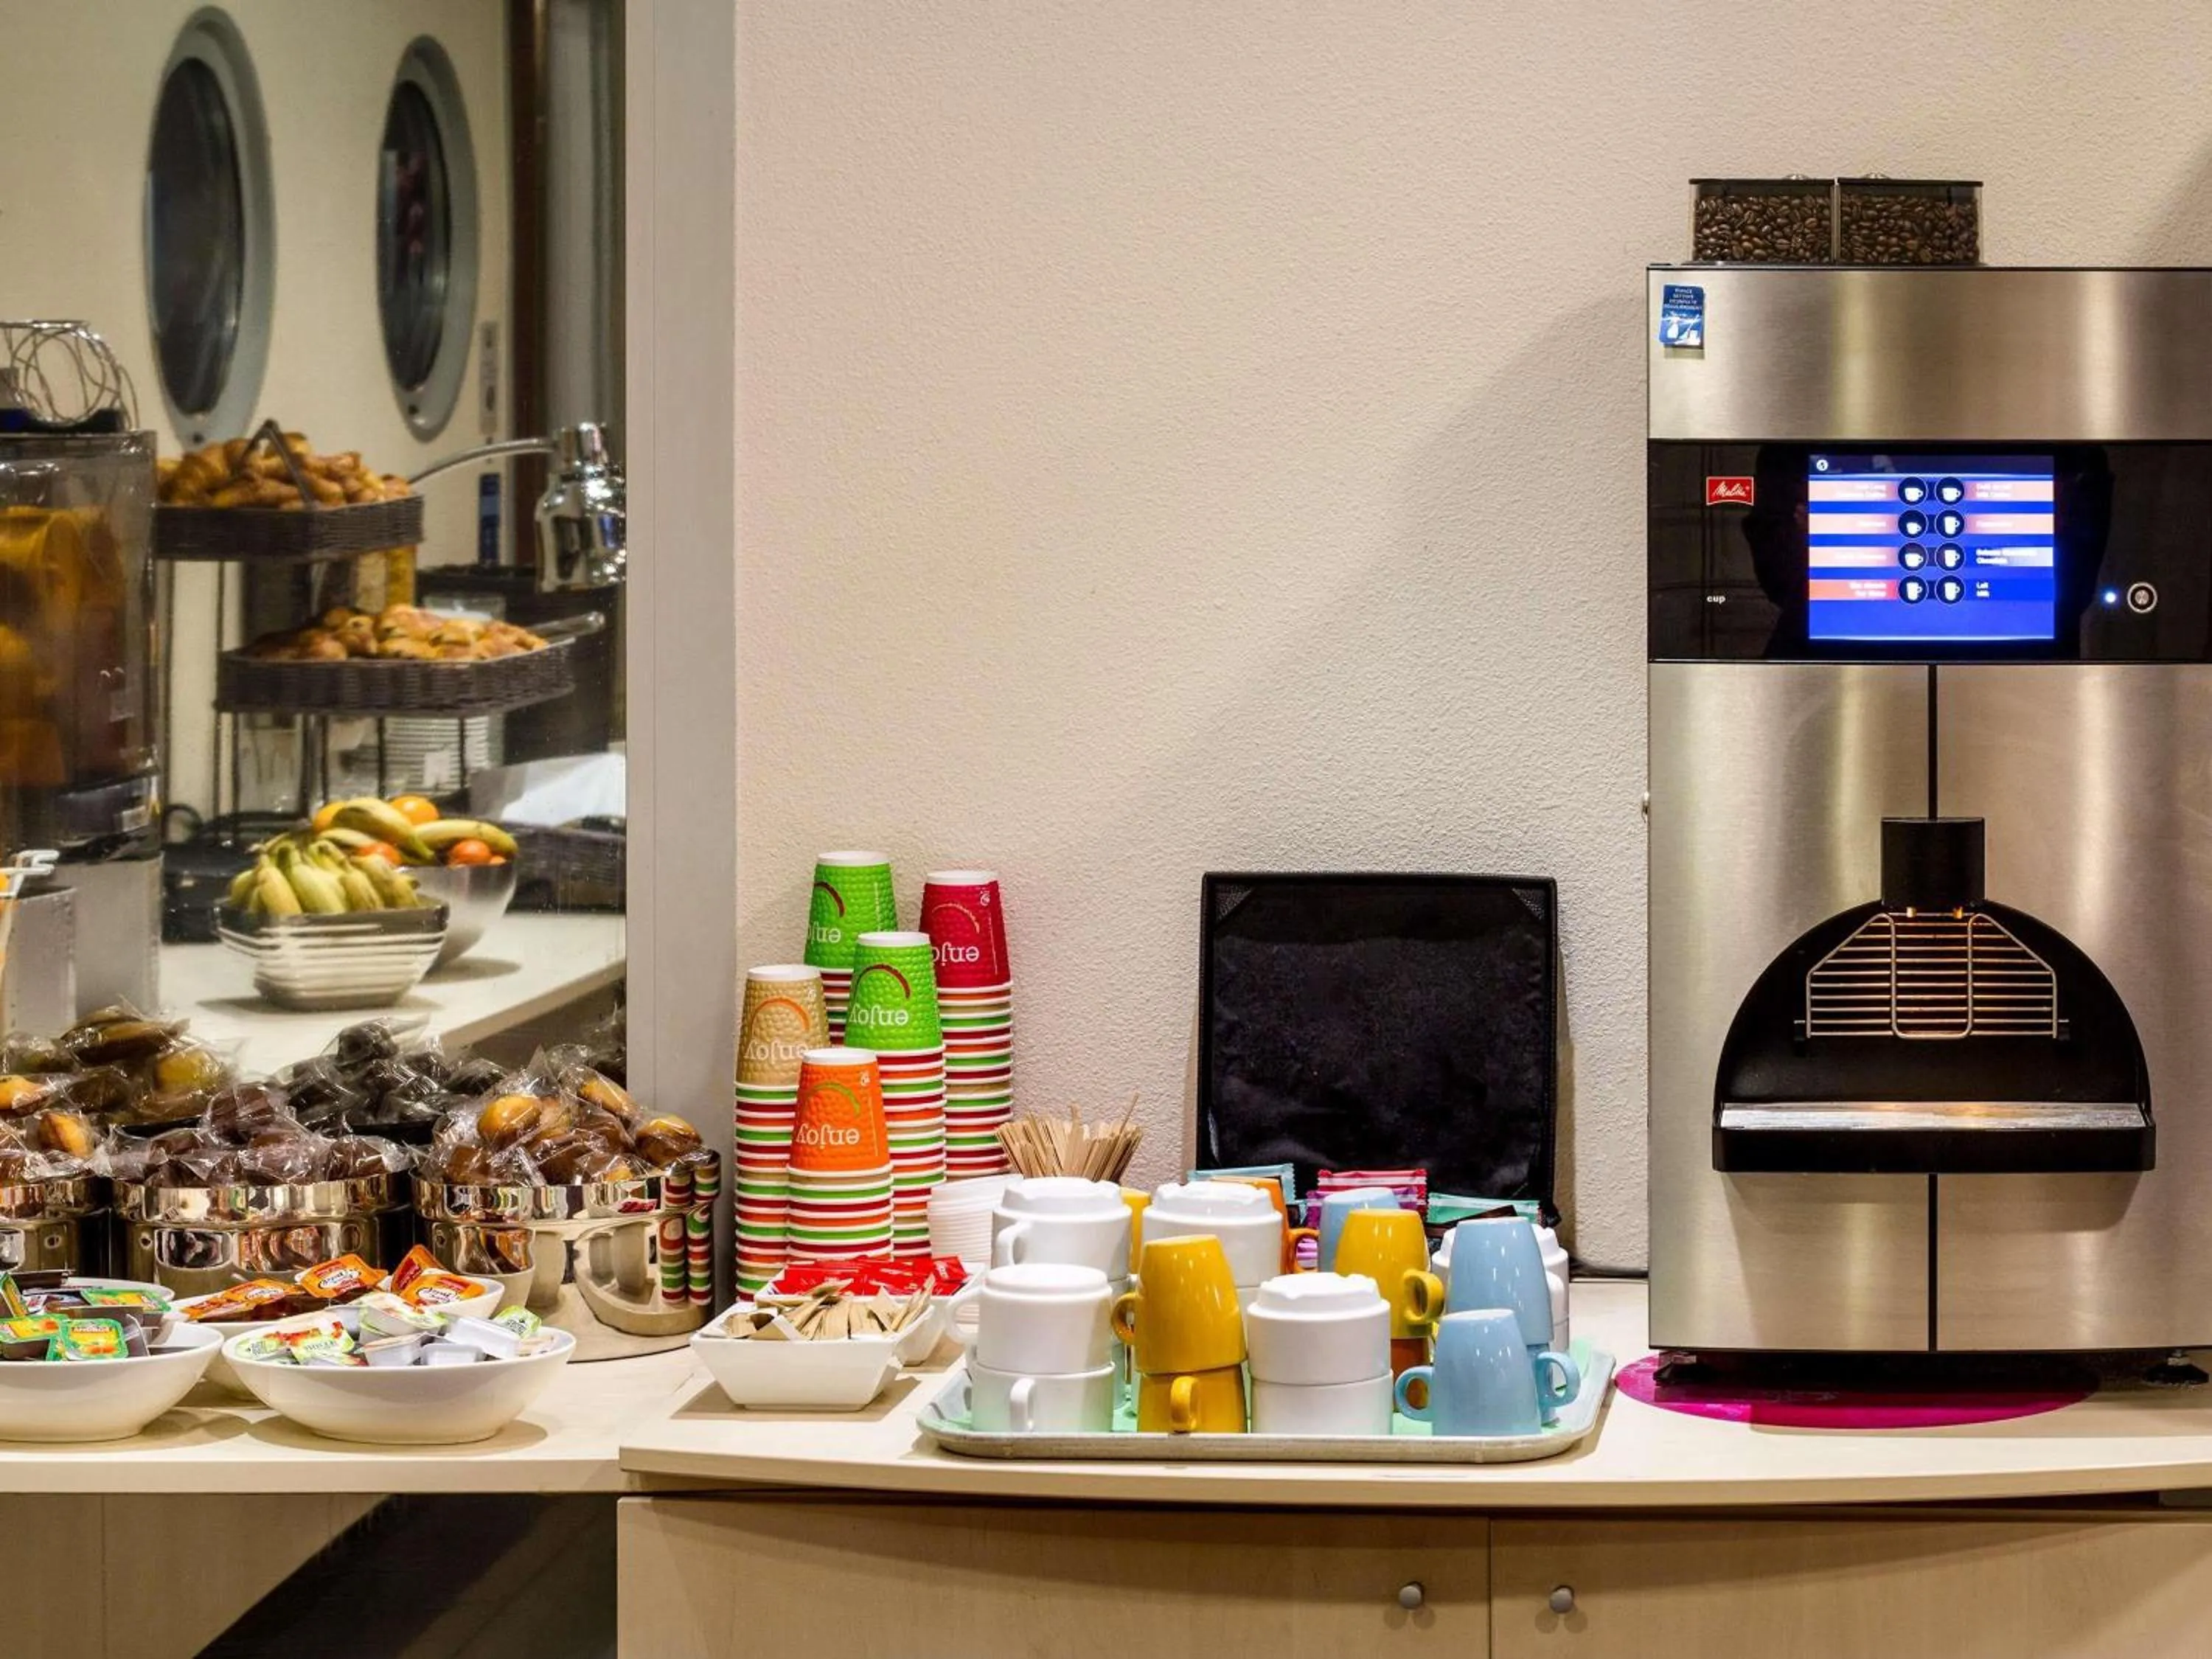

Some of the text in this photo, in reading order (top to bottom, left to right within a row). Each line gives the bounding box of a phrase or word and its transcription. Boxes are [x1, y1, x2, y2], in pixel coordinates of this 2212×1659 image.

[1706, 595, 1726, 605] cup
[932, 942, 980, 967] enjo
[849, 1004, 910, 1030] enjoy
[796, 1123, 860, 1150] enjoy
